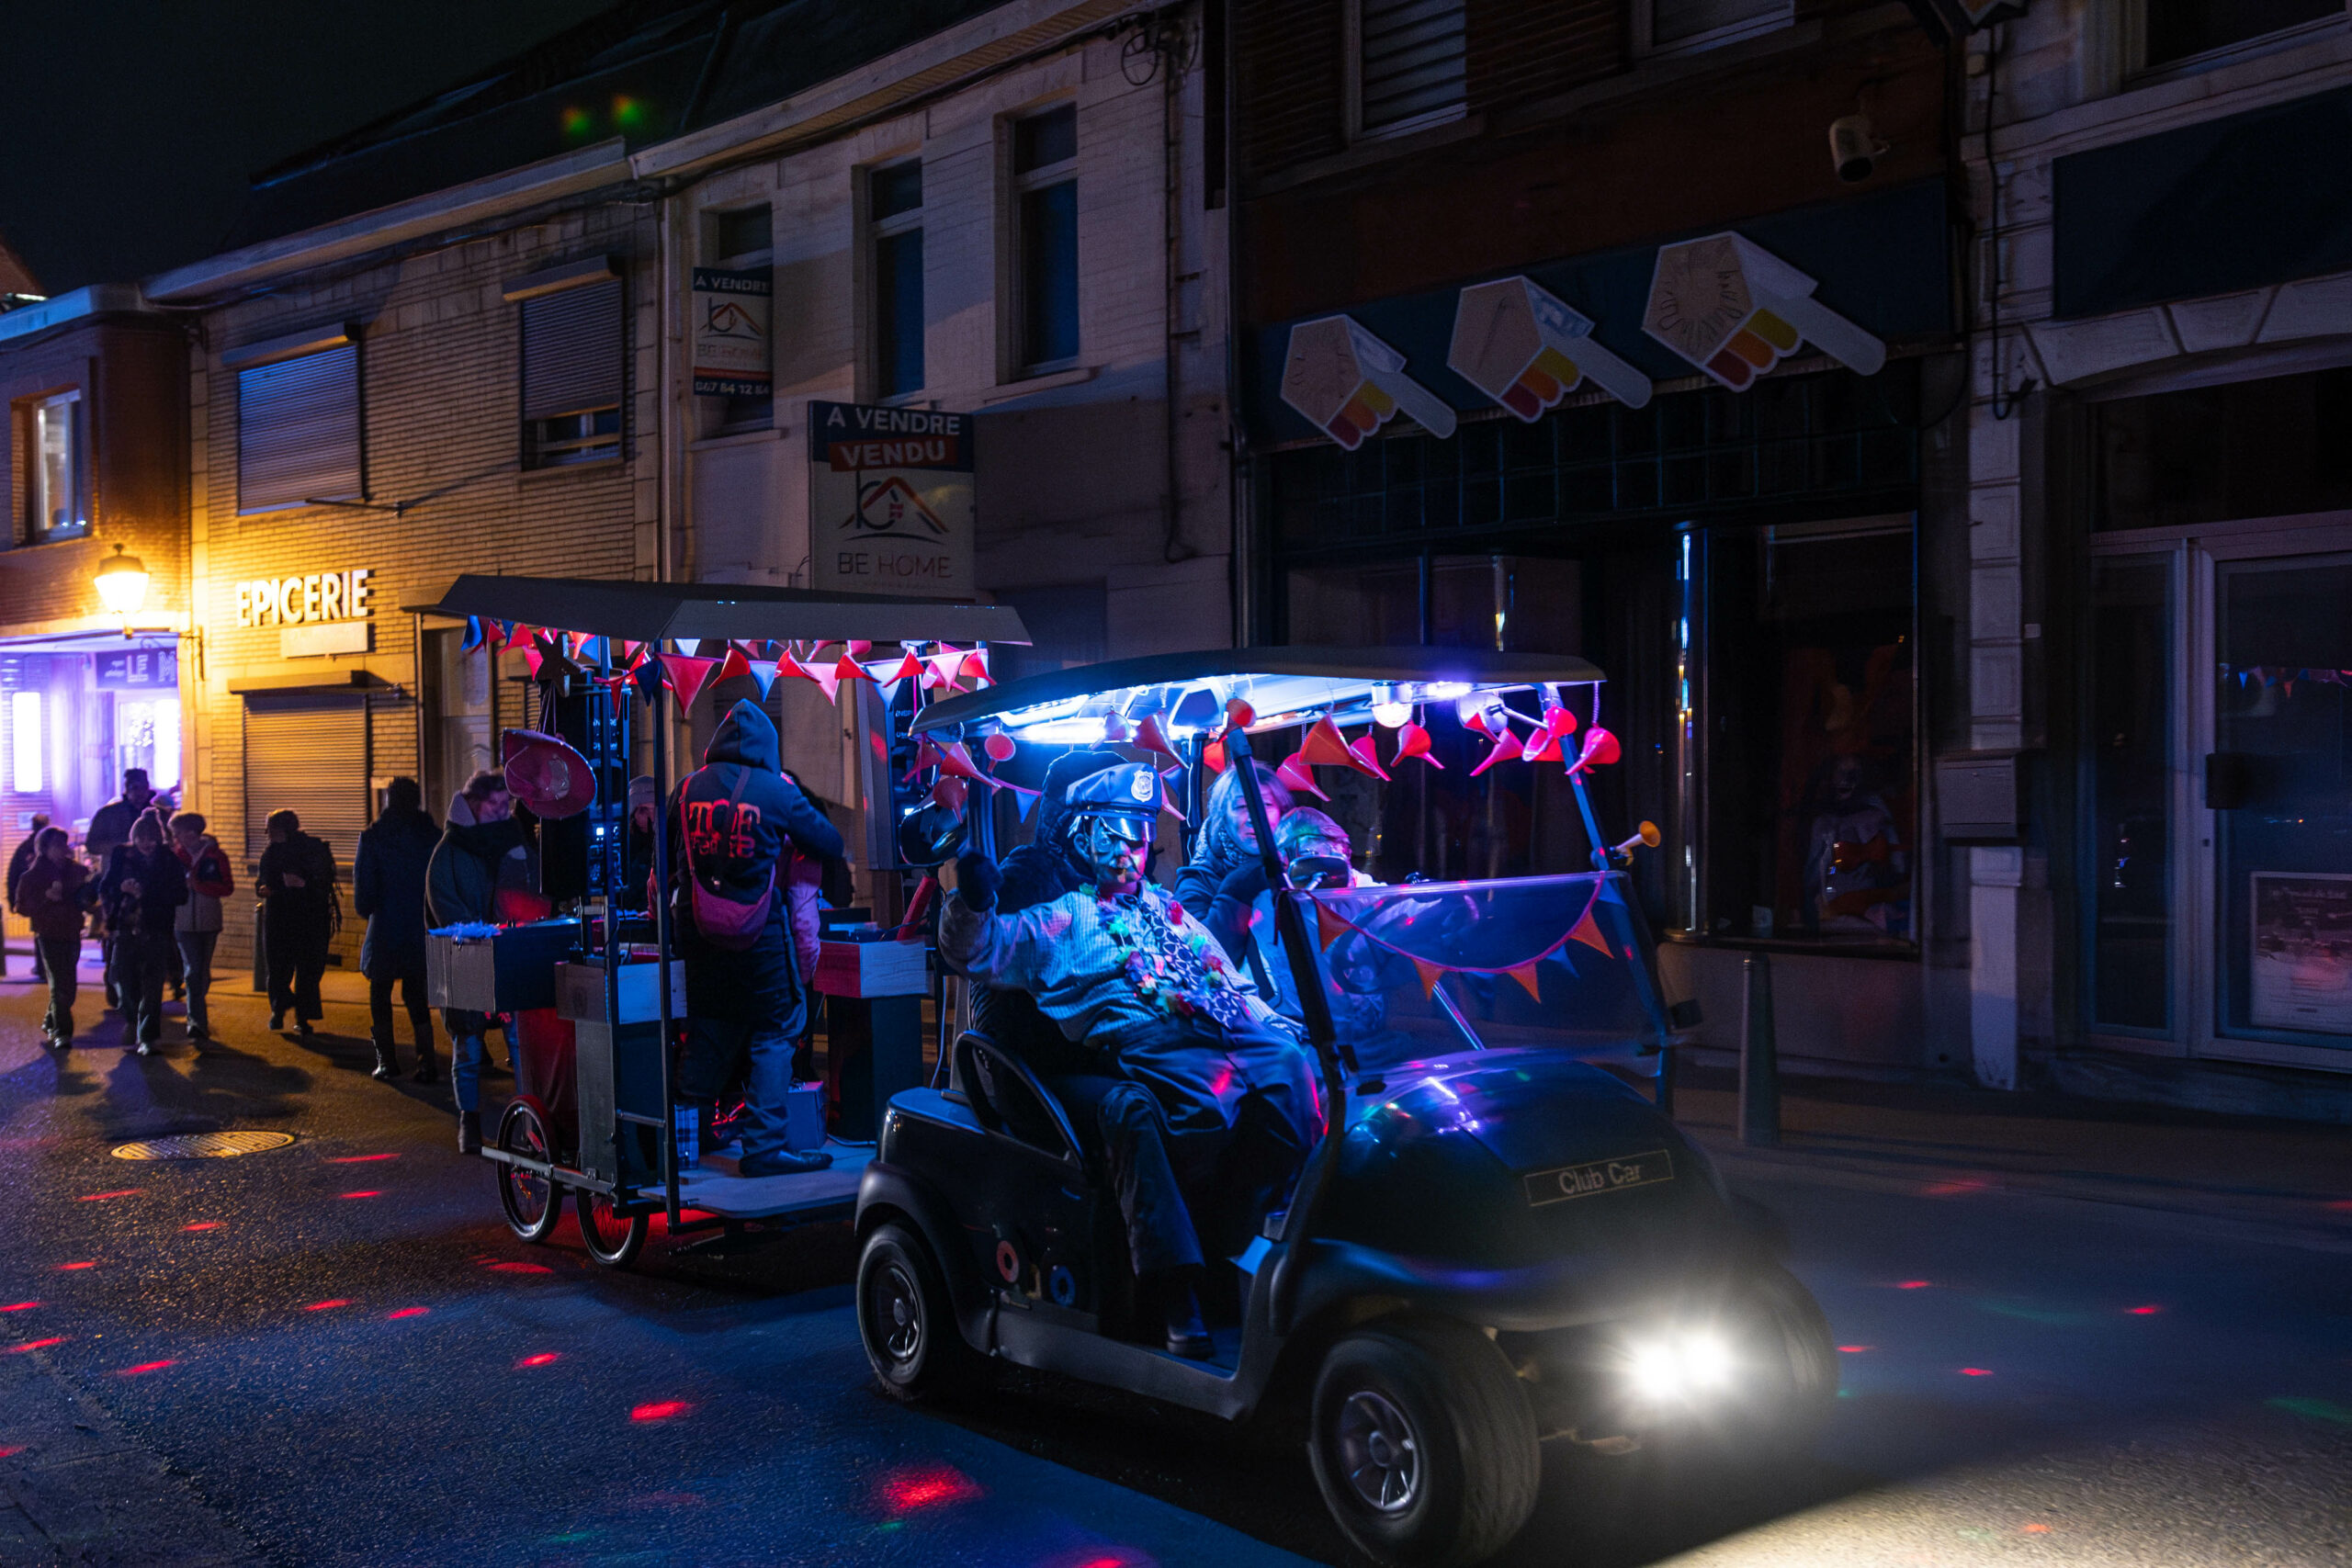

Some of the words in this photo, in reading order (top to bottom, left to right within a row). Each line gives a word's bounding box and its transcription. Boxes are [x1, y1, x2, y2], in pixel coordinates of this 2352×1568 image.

[695, 275, 707, 287] A
[710, 276, 771, 292] VENDRE
[738, 384, 752, 395] 12
[827, 405, 846, 428] A
[855, 407, 961, 435] VENDRE
[840, 440, 945, 467] VENDU
[838, 552, 869, 575] BE
[878, 555, 953, 578] HOME
[235, 569, 368, 627] EPICERIE
[127, 654, 149, 682] LE
[1558, 1167, 1605, 1194] Club
[1608, 1162, 1645, 1185] Car
